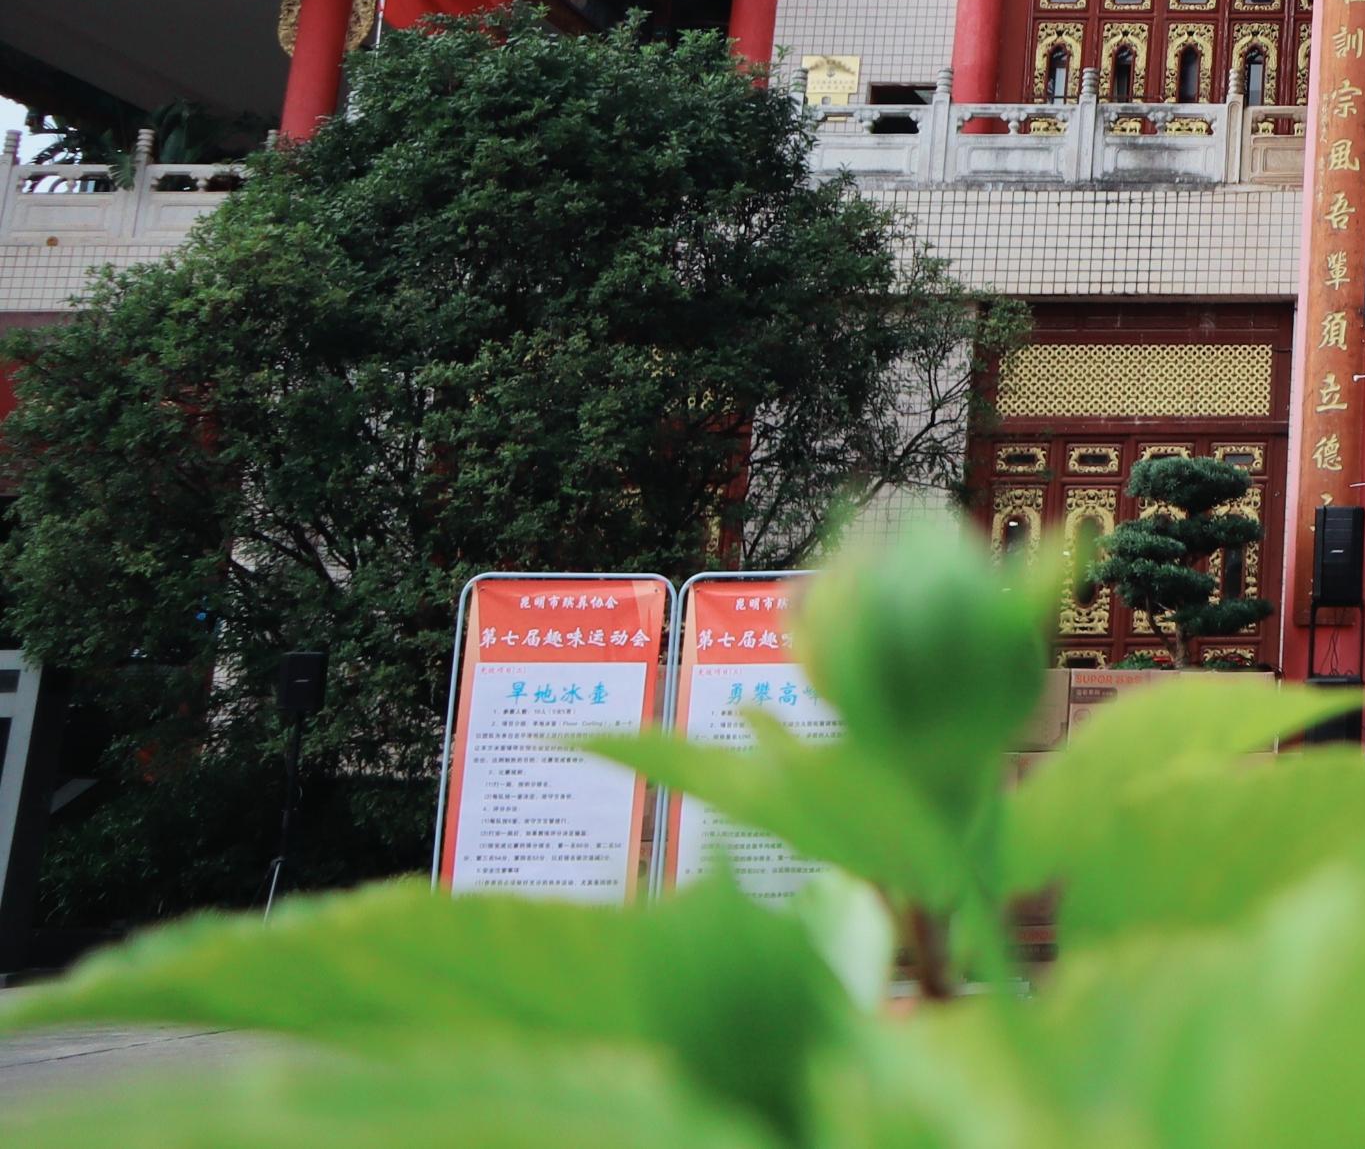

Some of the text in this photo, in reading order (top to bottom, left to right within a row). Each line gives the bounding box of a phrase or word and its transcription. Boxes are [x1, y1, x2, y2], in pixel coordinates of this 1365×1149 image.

[519, 595, 619, 610] 昆明市殡葬协会
[479, 626, 651, 648] 第七届趣味运动会
[1076, 675, 1113, 684] SUPOR
[506, 681, 609, 705] 旱地冰壶
